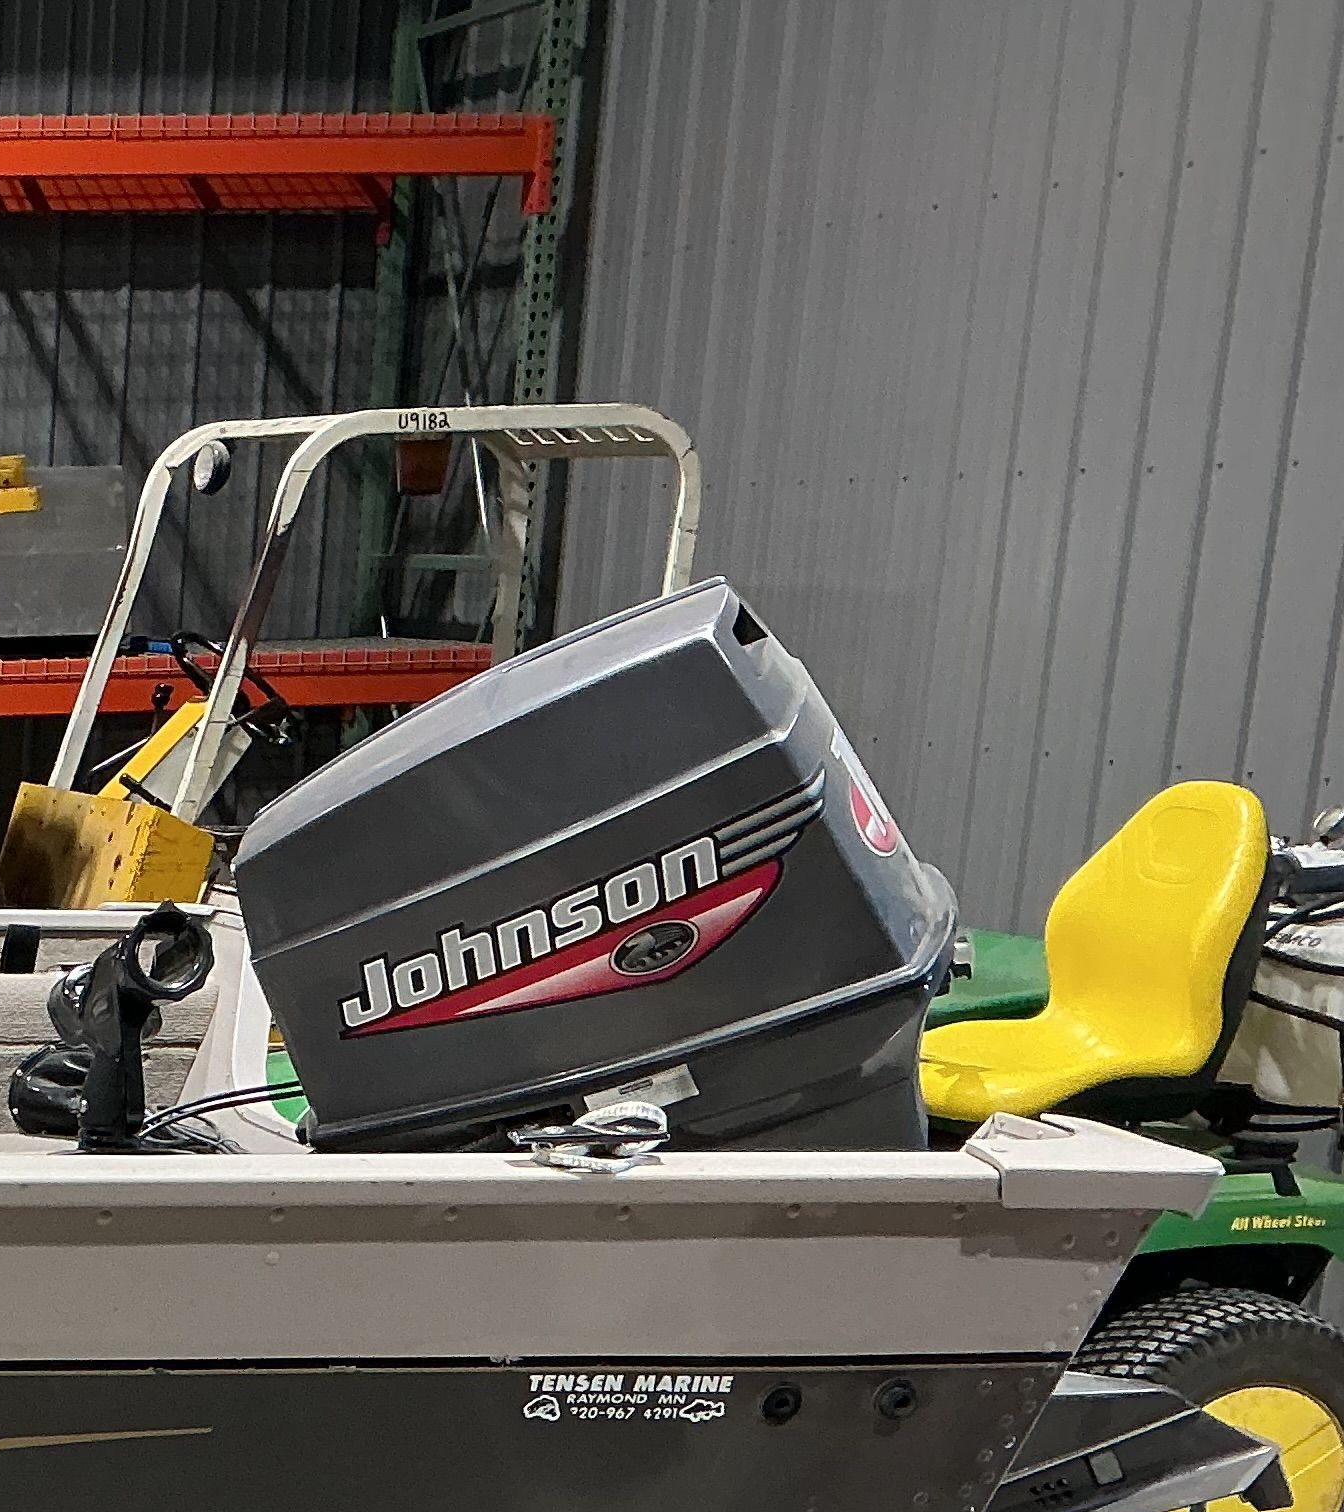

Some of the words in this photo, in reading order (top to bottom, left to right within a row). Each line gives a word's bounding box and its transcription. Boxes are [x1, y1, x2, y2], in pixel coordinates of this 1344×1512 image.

[340, 835, 718, 1029] Johnson
[529, 1374, 625, 1392] TENSEN
[633, 1375, 734, 1393] MARINE
[566, 1393, 648, 1404] RAYMOND
[658, 1393, 687, 1405] MN
[643, 1407, 678, 1419] 4291
